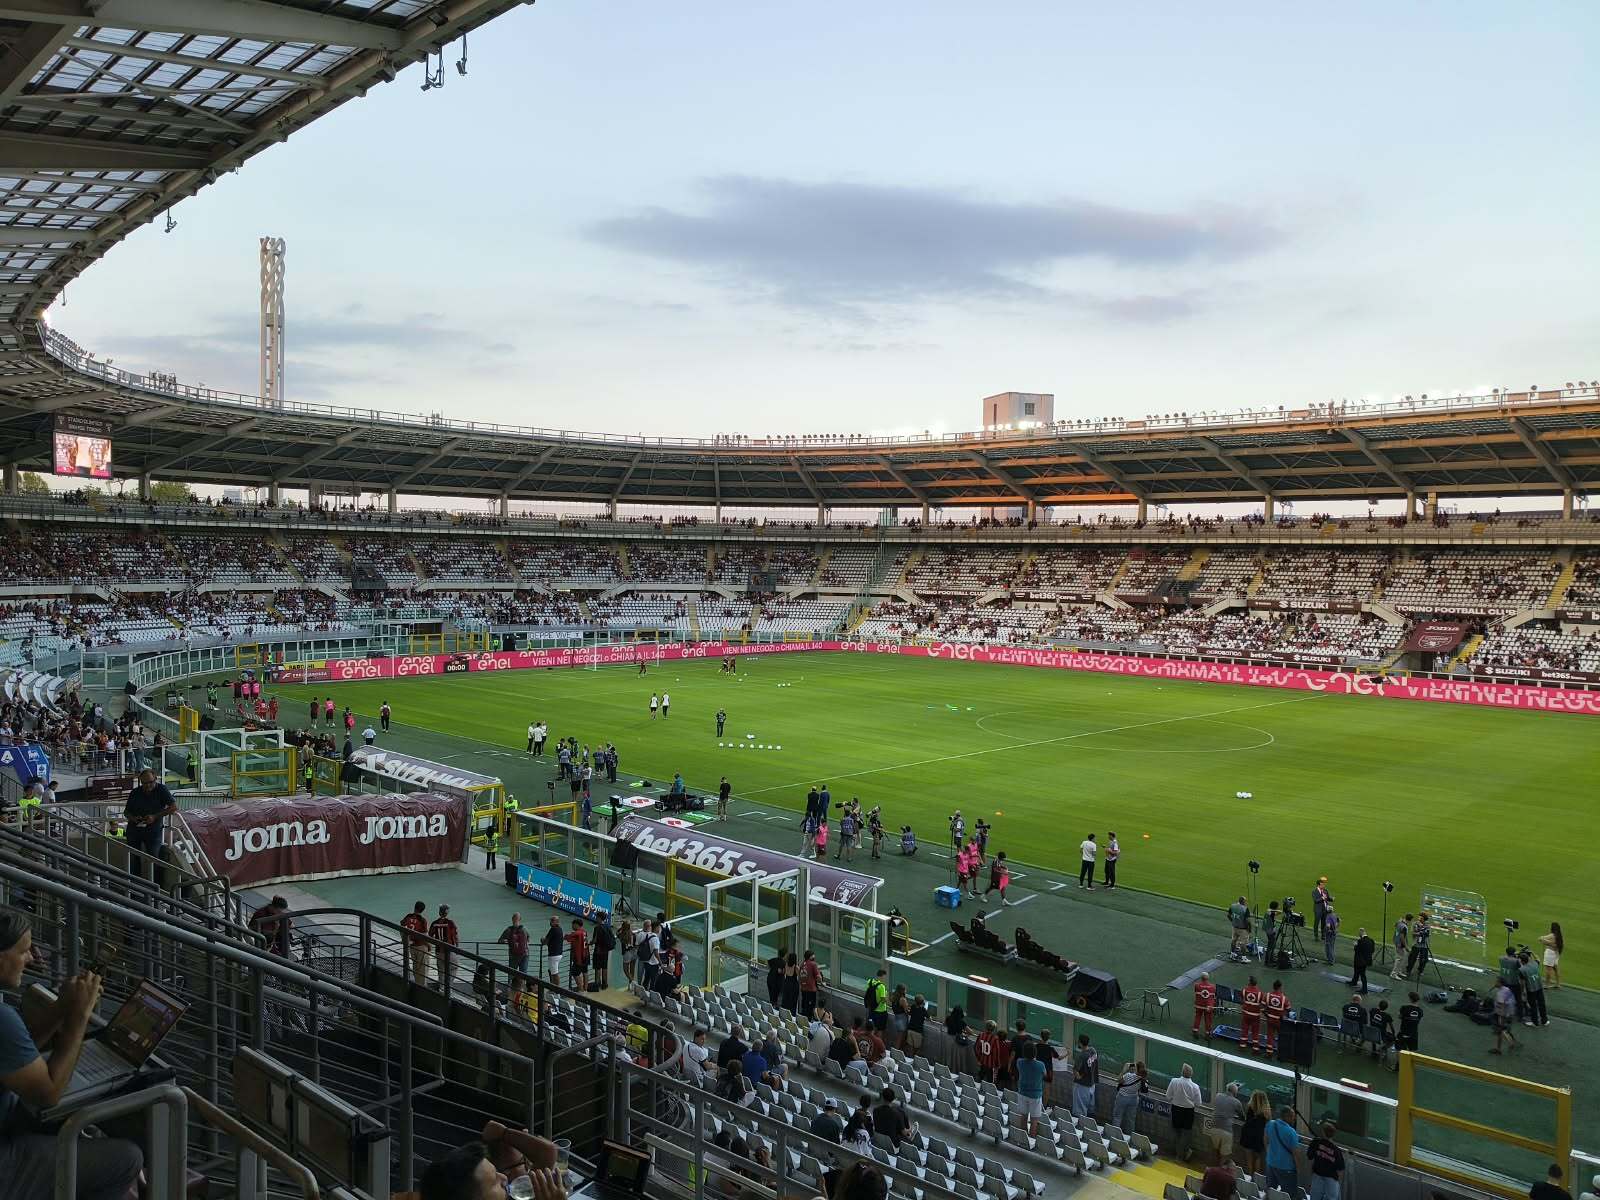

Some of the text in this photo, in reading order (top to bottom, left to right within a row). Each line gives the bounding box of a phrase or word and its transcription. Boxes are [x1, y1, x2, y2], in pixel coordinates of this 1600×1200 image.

[1290, 601, 1329, 609] SUZUKI
[1396, 605, 1433, 613] TORINO
[1434, 607, 1486, 615] FOOTBALL
[753, 644, 775, 653] NEGOZI
[780, 643, 804, 651] CHIAMA
[840, 641, 868, 652] enel
[876, 643, 900, 654] enel
[681, 647, 707, 658] enel
[478, 657, 511, 670] enel
[532, 657, 556, 666] VIENI
[558, 656, 571, 665] NEI
[573, 654, 603, 664] NEGOZI
[1301, 655, 1331, 663] SUZUKI
[341, 664, 381, 679] enel
[398, 662, 435, 676] enel
[1495, 667, 1531, 676] SUZUKI
[1542, 671, 1571, 679] bet365
[360, 813, 448, 844] Joma
[224, 819, 331, 861] Joma
[633, 827, 743, 875] bet365
[980, 1039, 991, 1056] 10
